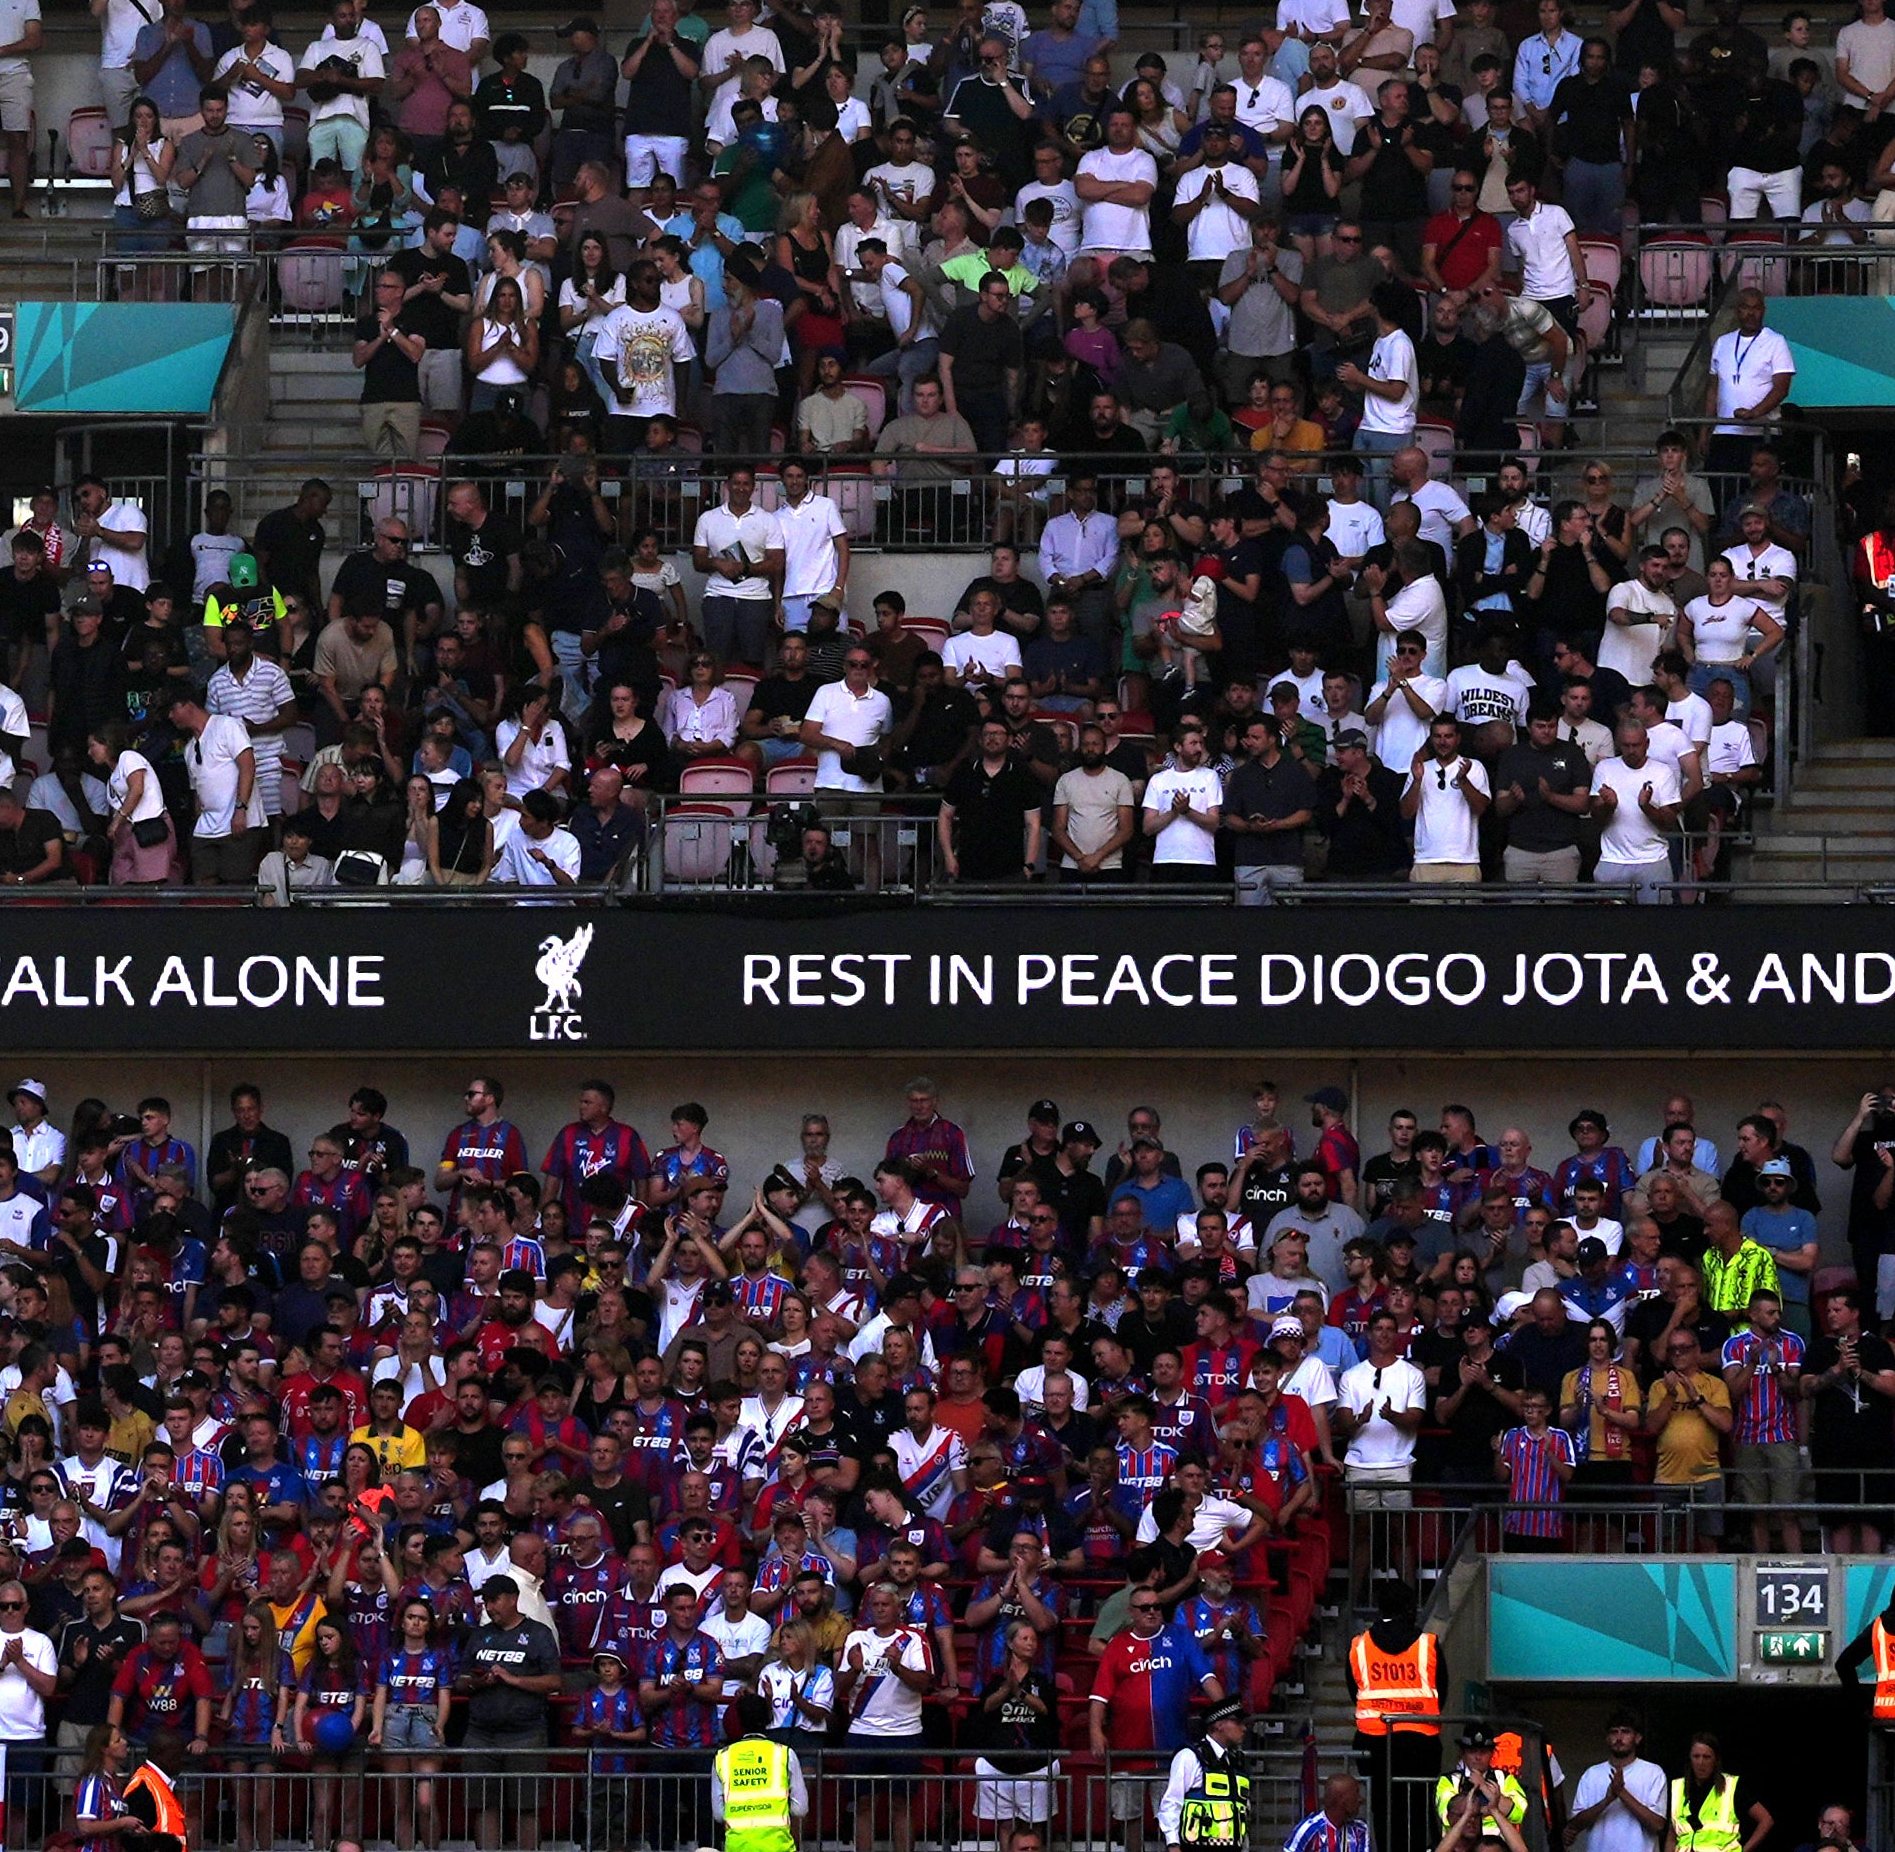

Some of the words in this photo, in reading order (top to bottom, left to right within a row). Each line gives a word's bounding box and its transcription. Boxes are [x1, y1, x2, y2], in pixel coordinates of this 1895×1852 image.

[1458, 689, 1516, 707] WILDEST
[150, 954, 385, 1008] ALONE
[744, 953, 912, 1007] REST
[930, 954, 993, 1005] IN
[1018, 953, 1238, 1007] PEACE
[1261, 952, 1486, 1007] DIOGO
[1503, 952, 1669, 1006] JOTA
[1686, 952, 1731, 1006] &
[1244, 1187, 1288, 1202] cinch
[1207, 1372, 1240, 1385] TDK
[1149, 1426, 1185, 1438] TDK
[632, 1435, 672, 1449] ET88
[562, 1587, 607, 1605] cinch
[1760, 1582, 1825, 1614] 134
[475, 1647, 526, 1663] NET88
[1128, 1654, 1172, 1673] cinch
[1369, 1661, 1417, 1681] S1013
[146, 1699, 176, 1712] W88
[731, 1766, 767, 1776] SENIOR
[731, 1777, 769, 1786] SAFETY
